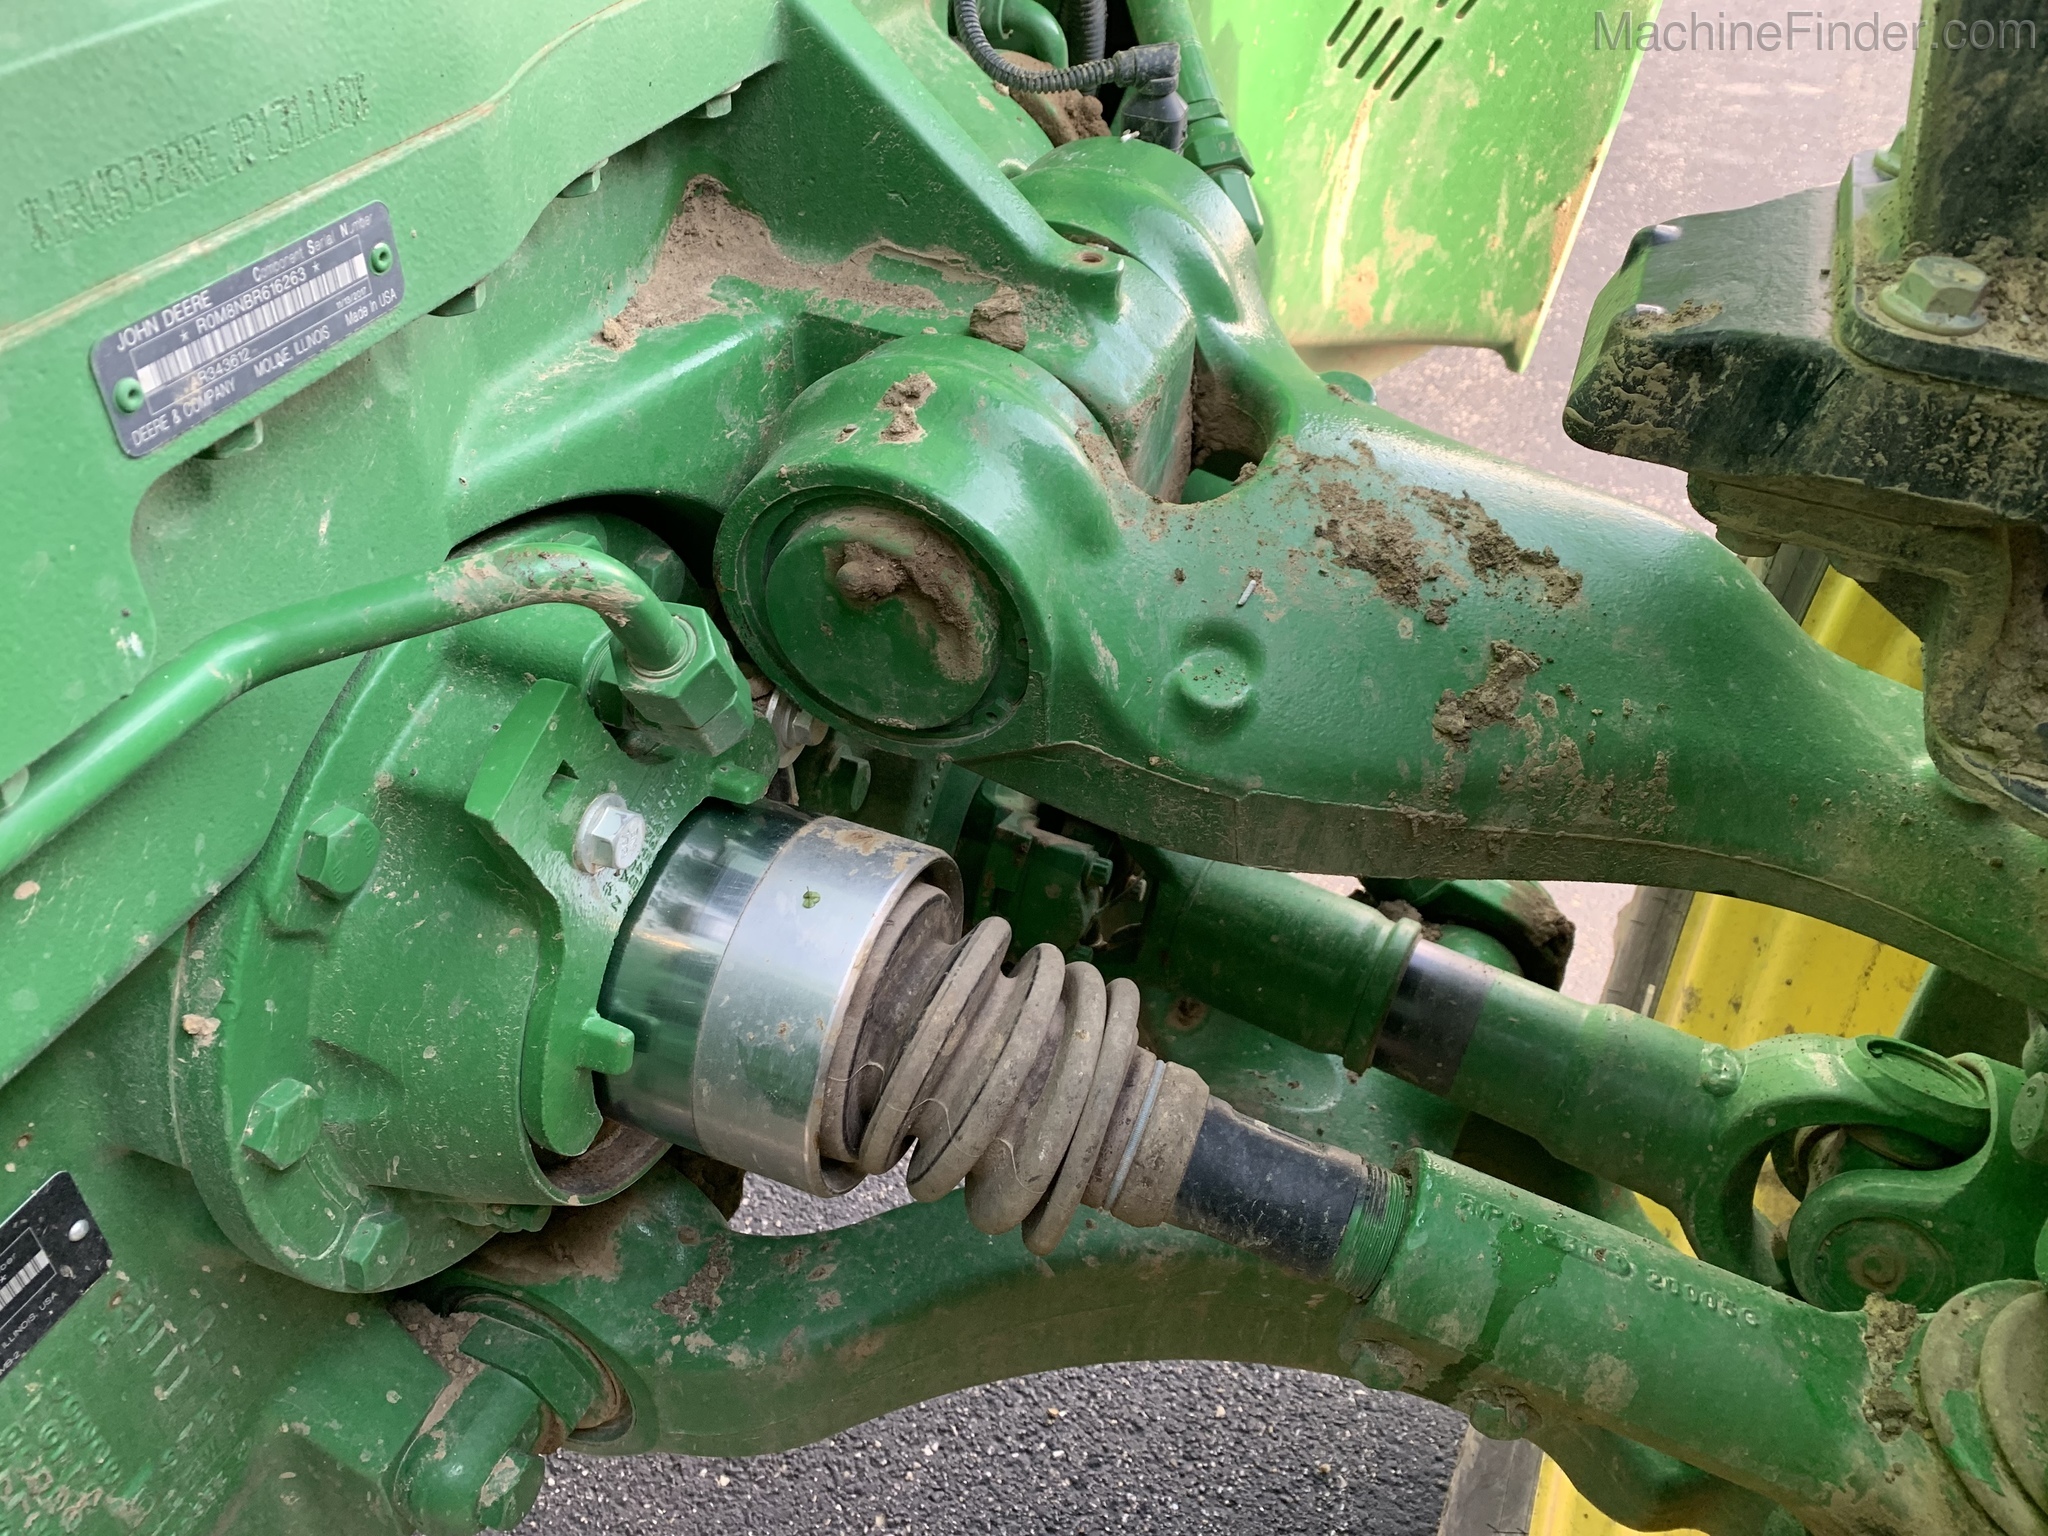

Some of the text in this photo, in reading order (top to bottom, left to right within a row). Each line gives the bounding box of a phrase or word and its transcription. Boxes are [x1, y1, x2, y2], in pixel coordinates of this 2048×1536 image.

[252, 247, 303, 283] Component
[306, 233, 336, 255] Serial
[116, 290, 213, 352] JOHN DEERE
[344, 305, 369, 327] Made
[378, 287, 398, 308] USA
[295, 324, 331, 356] ILLINOIS
[131, 376, 236, 448] DEERE & COMPANY
[39, 1292, 59, 1312] USA
